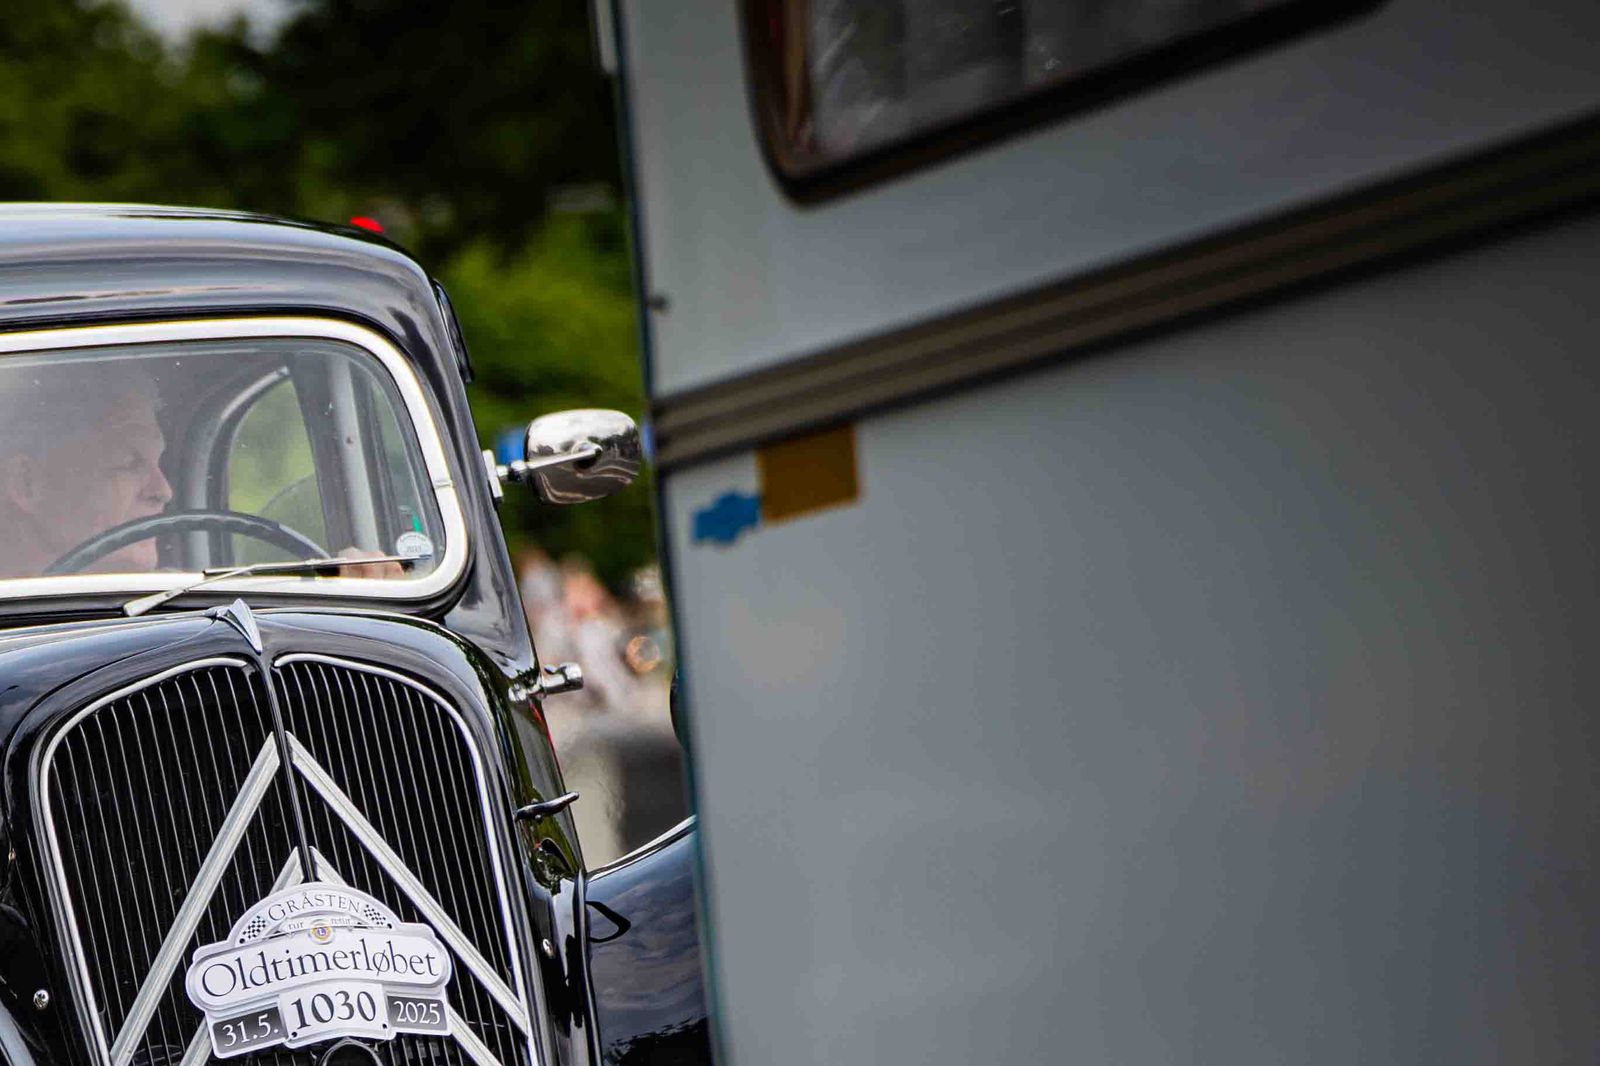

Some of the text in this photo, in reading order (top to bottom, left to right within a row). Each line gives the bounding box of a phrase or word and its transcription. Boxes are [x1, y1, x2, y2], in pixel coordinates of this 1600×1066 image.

[268, 892, 360, 921] GRÅSTEN
[202, 939, 439, 997] Oldtimerløbet
[222, 990, 441, 1047] 31.5. 1030 2025
